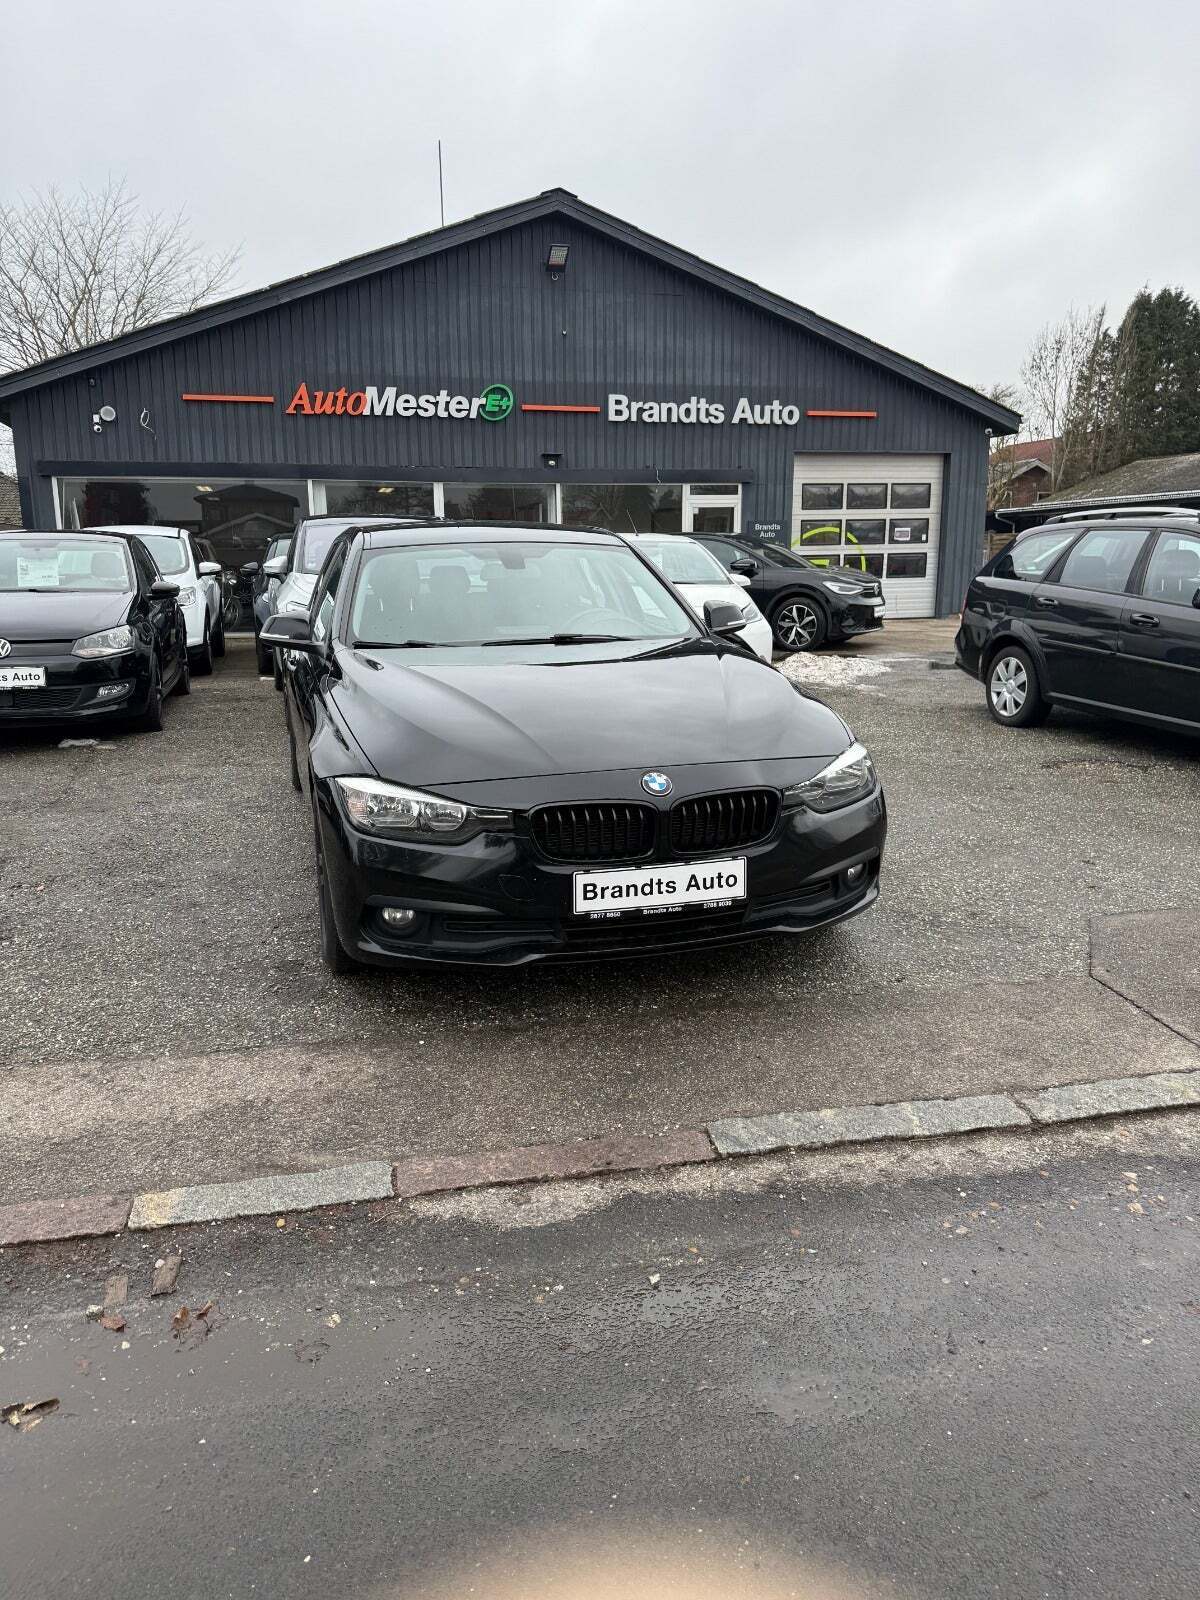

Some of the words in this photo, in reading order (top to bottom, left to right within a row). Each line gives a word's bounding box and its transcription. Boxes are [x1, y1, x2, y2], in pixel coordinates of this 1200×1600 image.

[286, 382, 486, 419] AutoMester
[607, 393, 725, 425] Brandts
[731, 397, 800, 426] Auto
[754, 523, 781, 531] Brandts
[12, 672, 41, 681] Auto
[582, 878, 677, 901] Brandts
[685, 872, 738, 892] Auto
